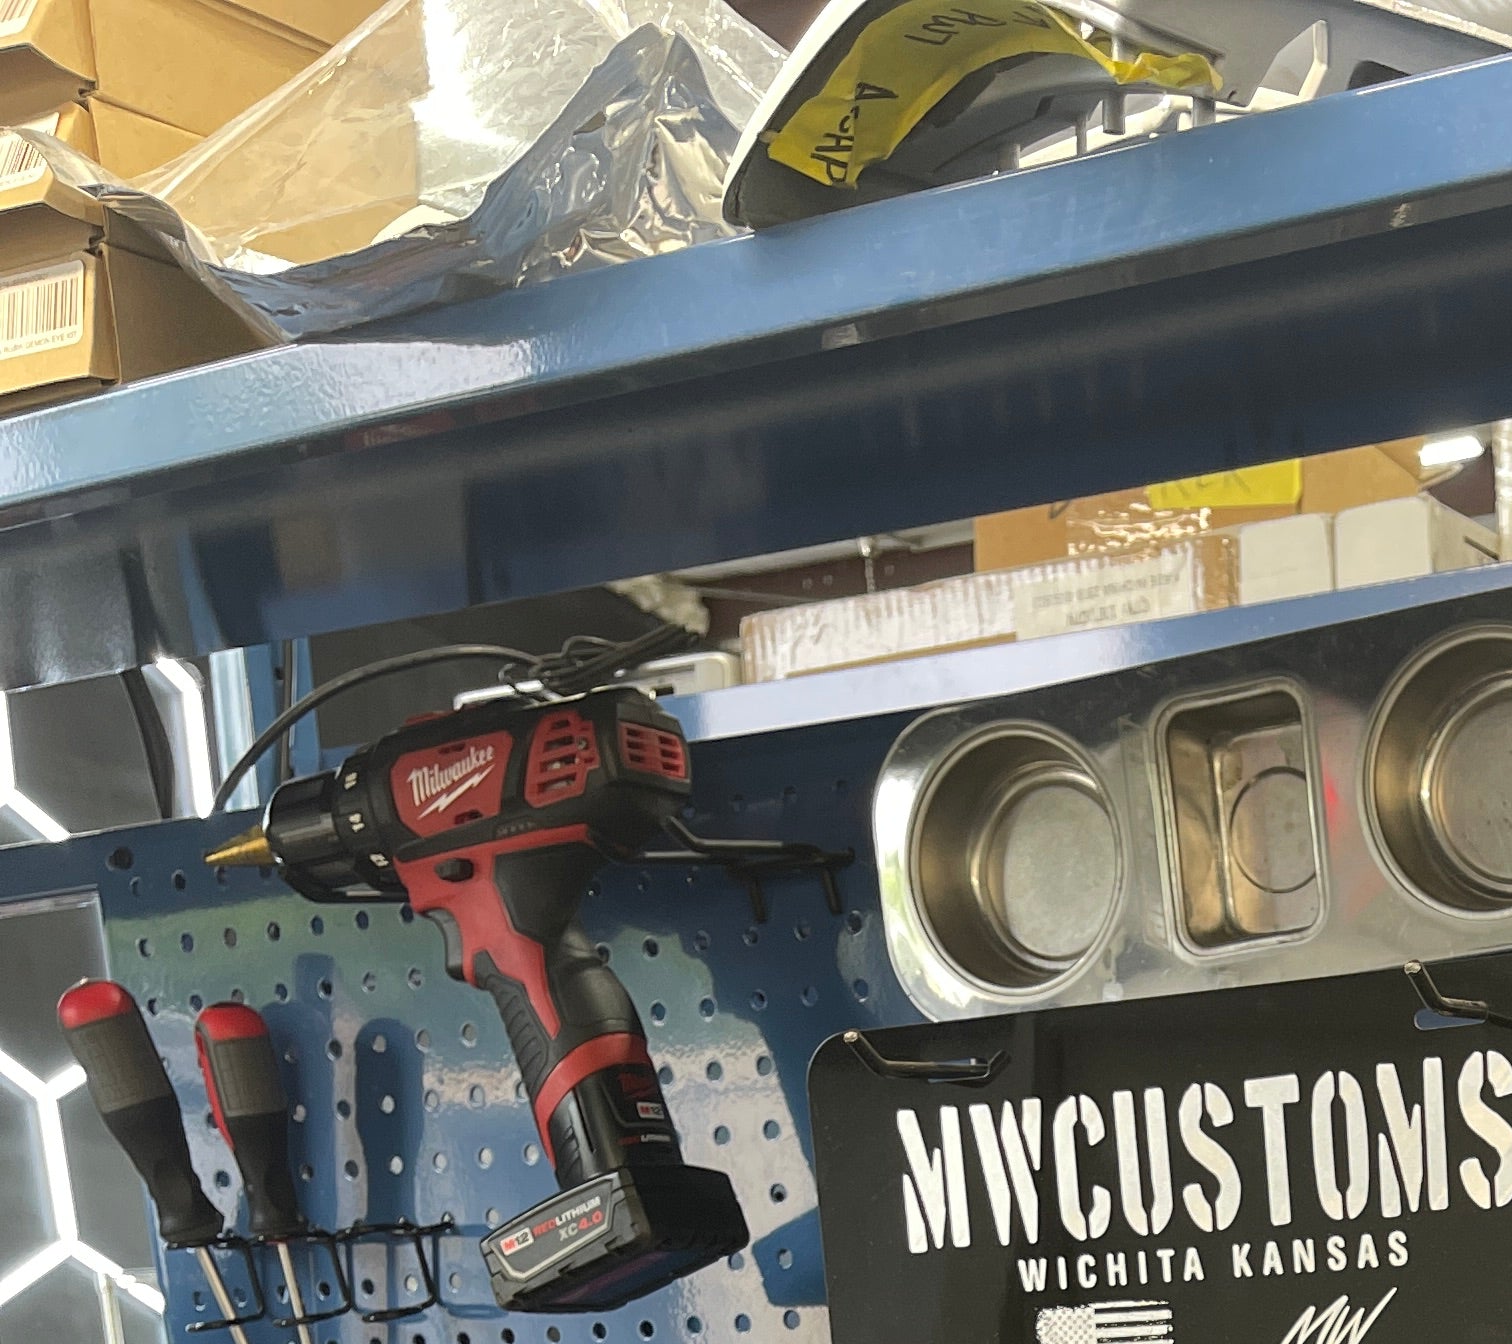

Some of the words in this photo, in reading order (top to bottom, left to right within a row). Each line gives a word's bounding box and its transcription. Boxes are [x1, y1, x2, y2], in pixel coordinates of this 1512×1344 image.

[406, 745, 495, 807] Milwaukee
[532, 1195, 601, 1237] REDLITHIUM
[1017, 1247, 1205, 1293] WICHITA
[1231, 1230, 1410, 1279] KANSAS
